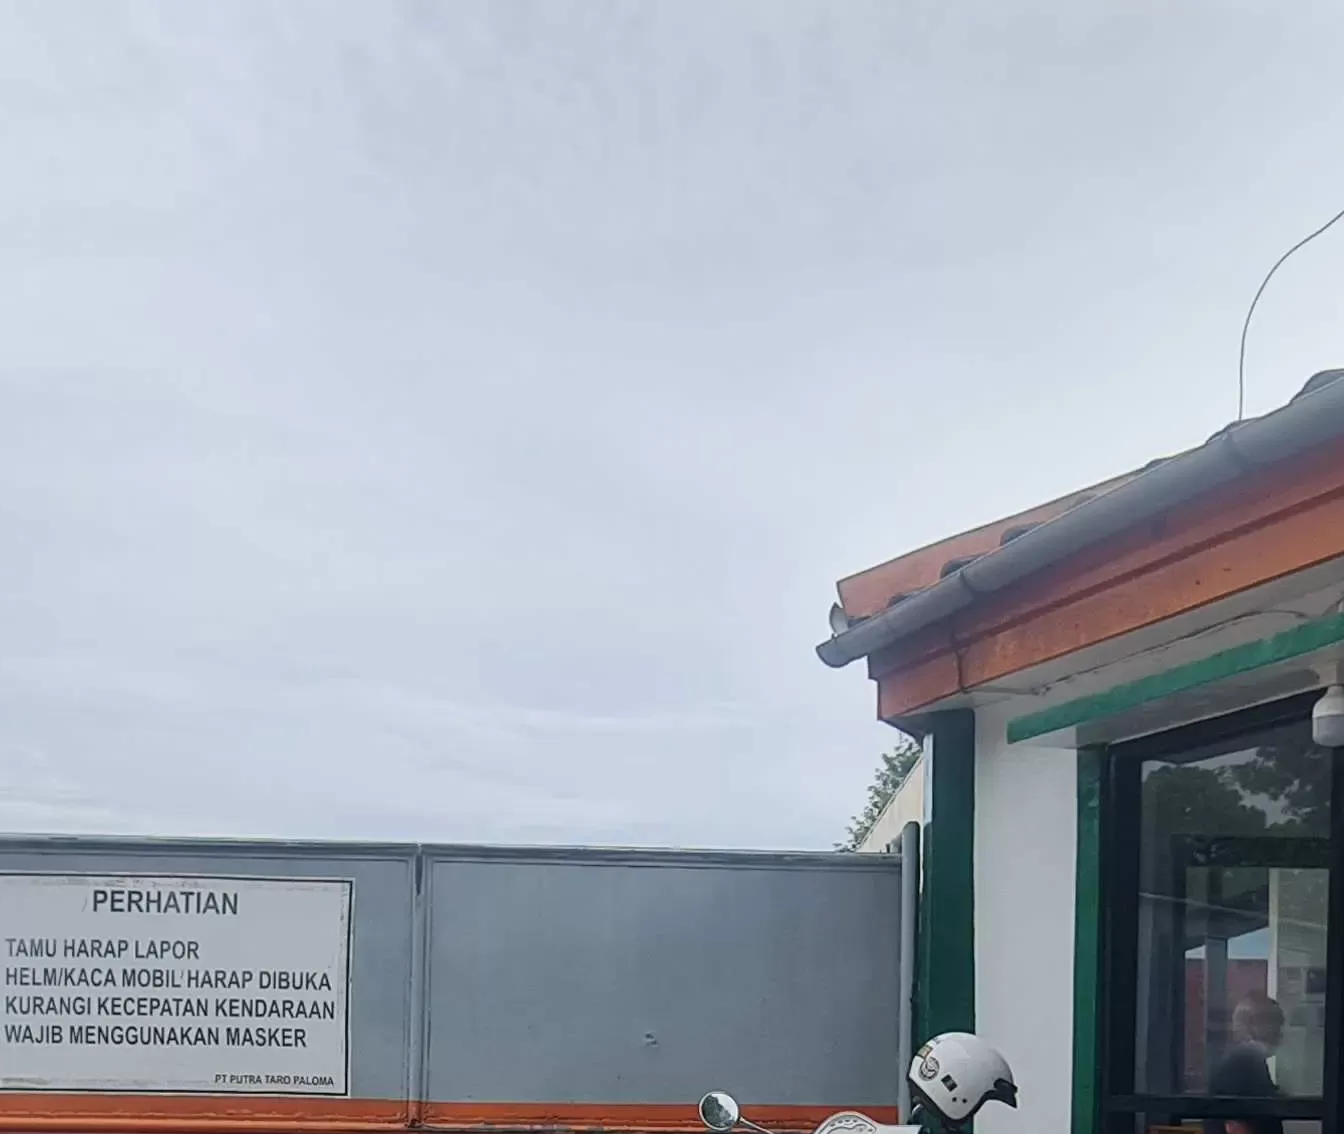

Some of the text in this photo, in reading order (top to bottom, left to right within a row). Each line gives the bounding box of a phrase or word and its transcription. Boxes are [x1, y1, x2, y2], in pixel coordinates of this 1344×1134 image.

[92, 889, 238, 915] PERHATIAN
[5, 938, 57, 958] TAMU
[63, 938, 129, 958] HARAP
[134, 940, 200, 960] LAPOR
[6, 967, 116, 987] HELM/KACA
[122, 968, 181, 988] MOBIL
[187, 969, 253, 989] HARAP
[259, 971, 332, 991] DIBUKA
[5, 996, 91, 1016] KURANGI
[97, 997, 208, 1017] KECEPATAN
[215, 999, 335, 1020] KENDARAAN
[4, 1024, 63, 1044] WAJIB
[69, 1025, 219, 1046] MENGGUNAKAN
[226, 1028, 307, 1048] MASKER
[215, 1074, 334, 1086] PT PUTRA TARO PALOMA
